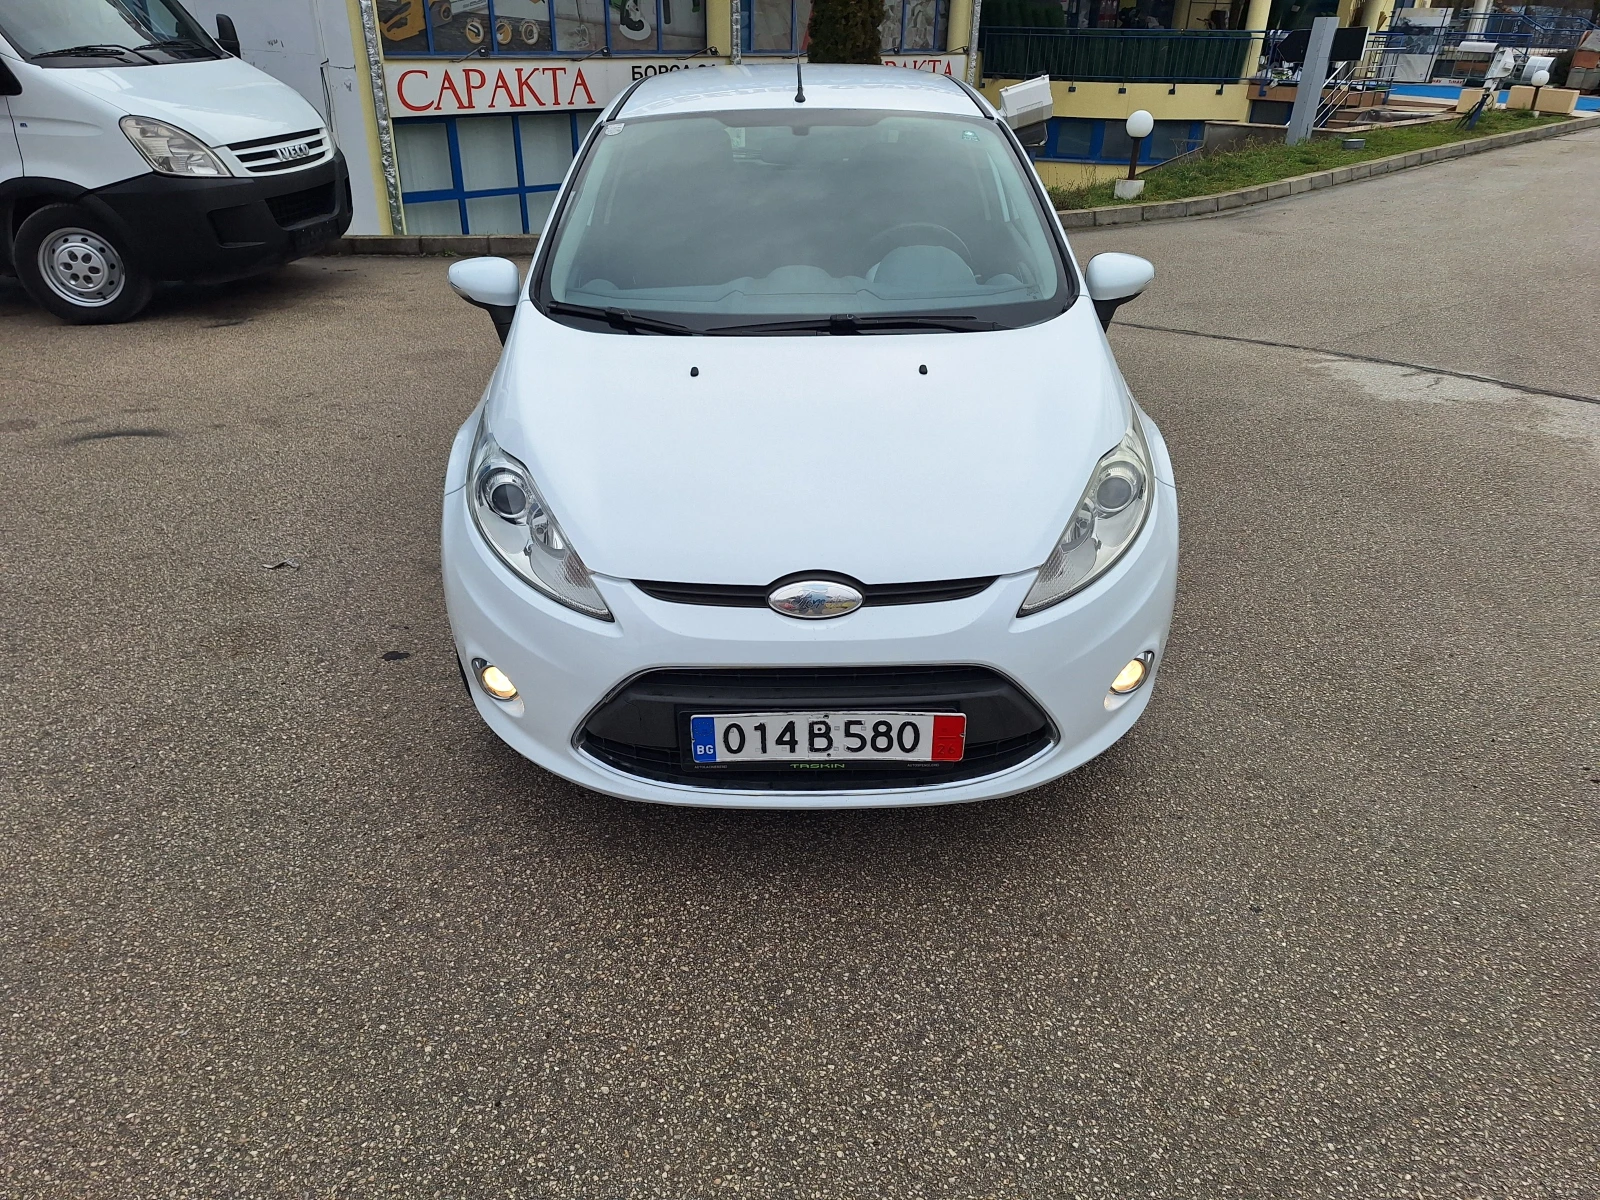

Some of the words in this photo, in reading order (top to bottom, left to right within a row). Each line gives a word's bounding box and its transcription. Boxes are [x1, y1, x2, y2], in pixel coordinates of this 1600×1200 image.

[397, 67, 595, 112] САРАКТА
[276, 143, 310, 161] IVECO
[696, 744, 714, 755] BG
